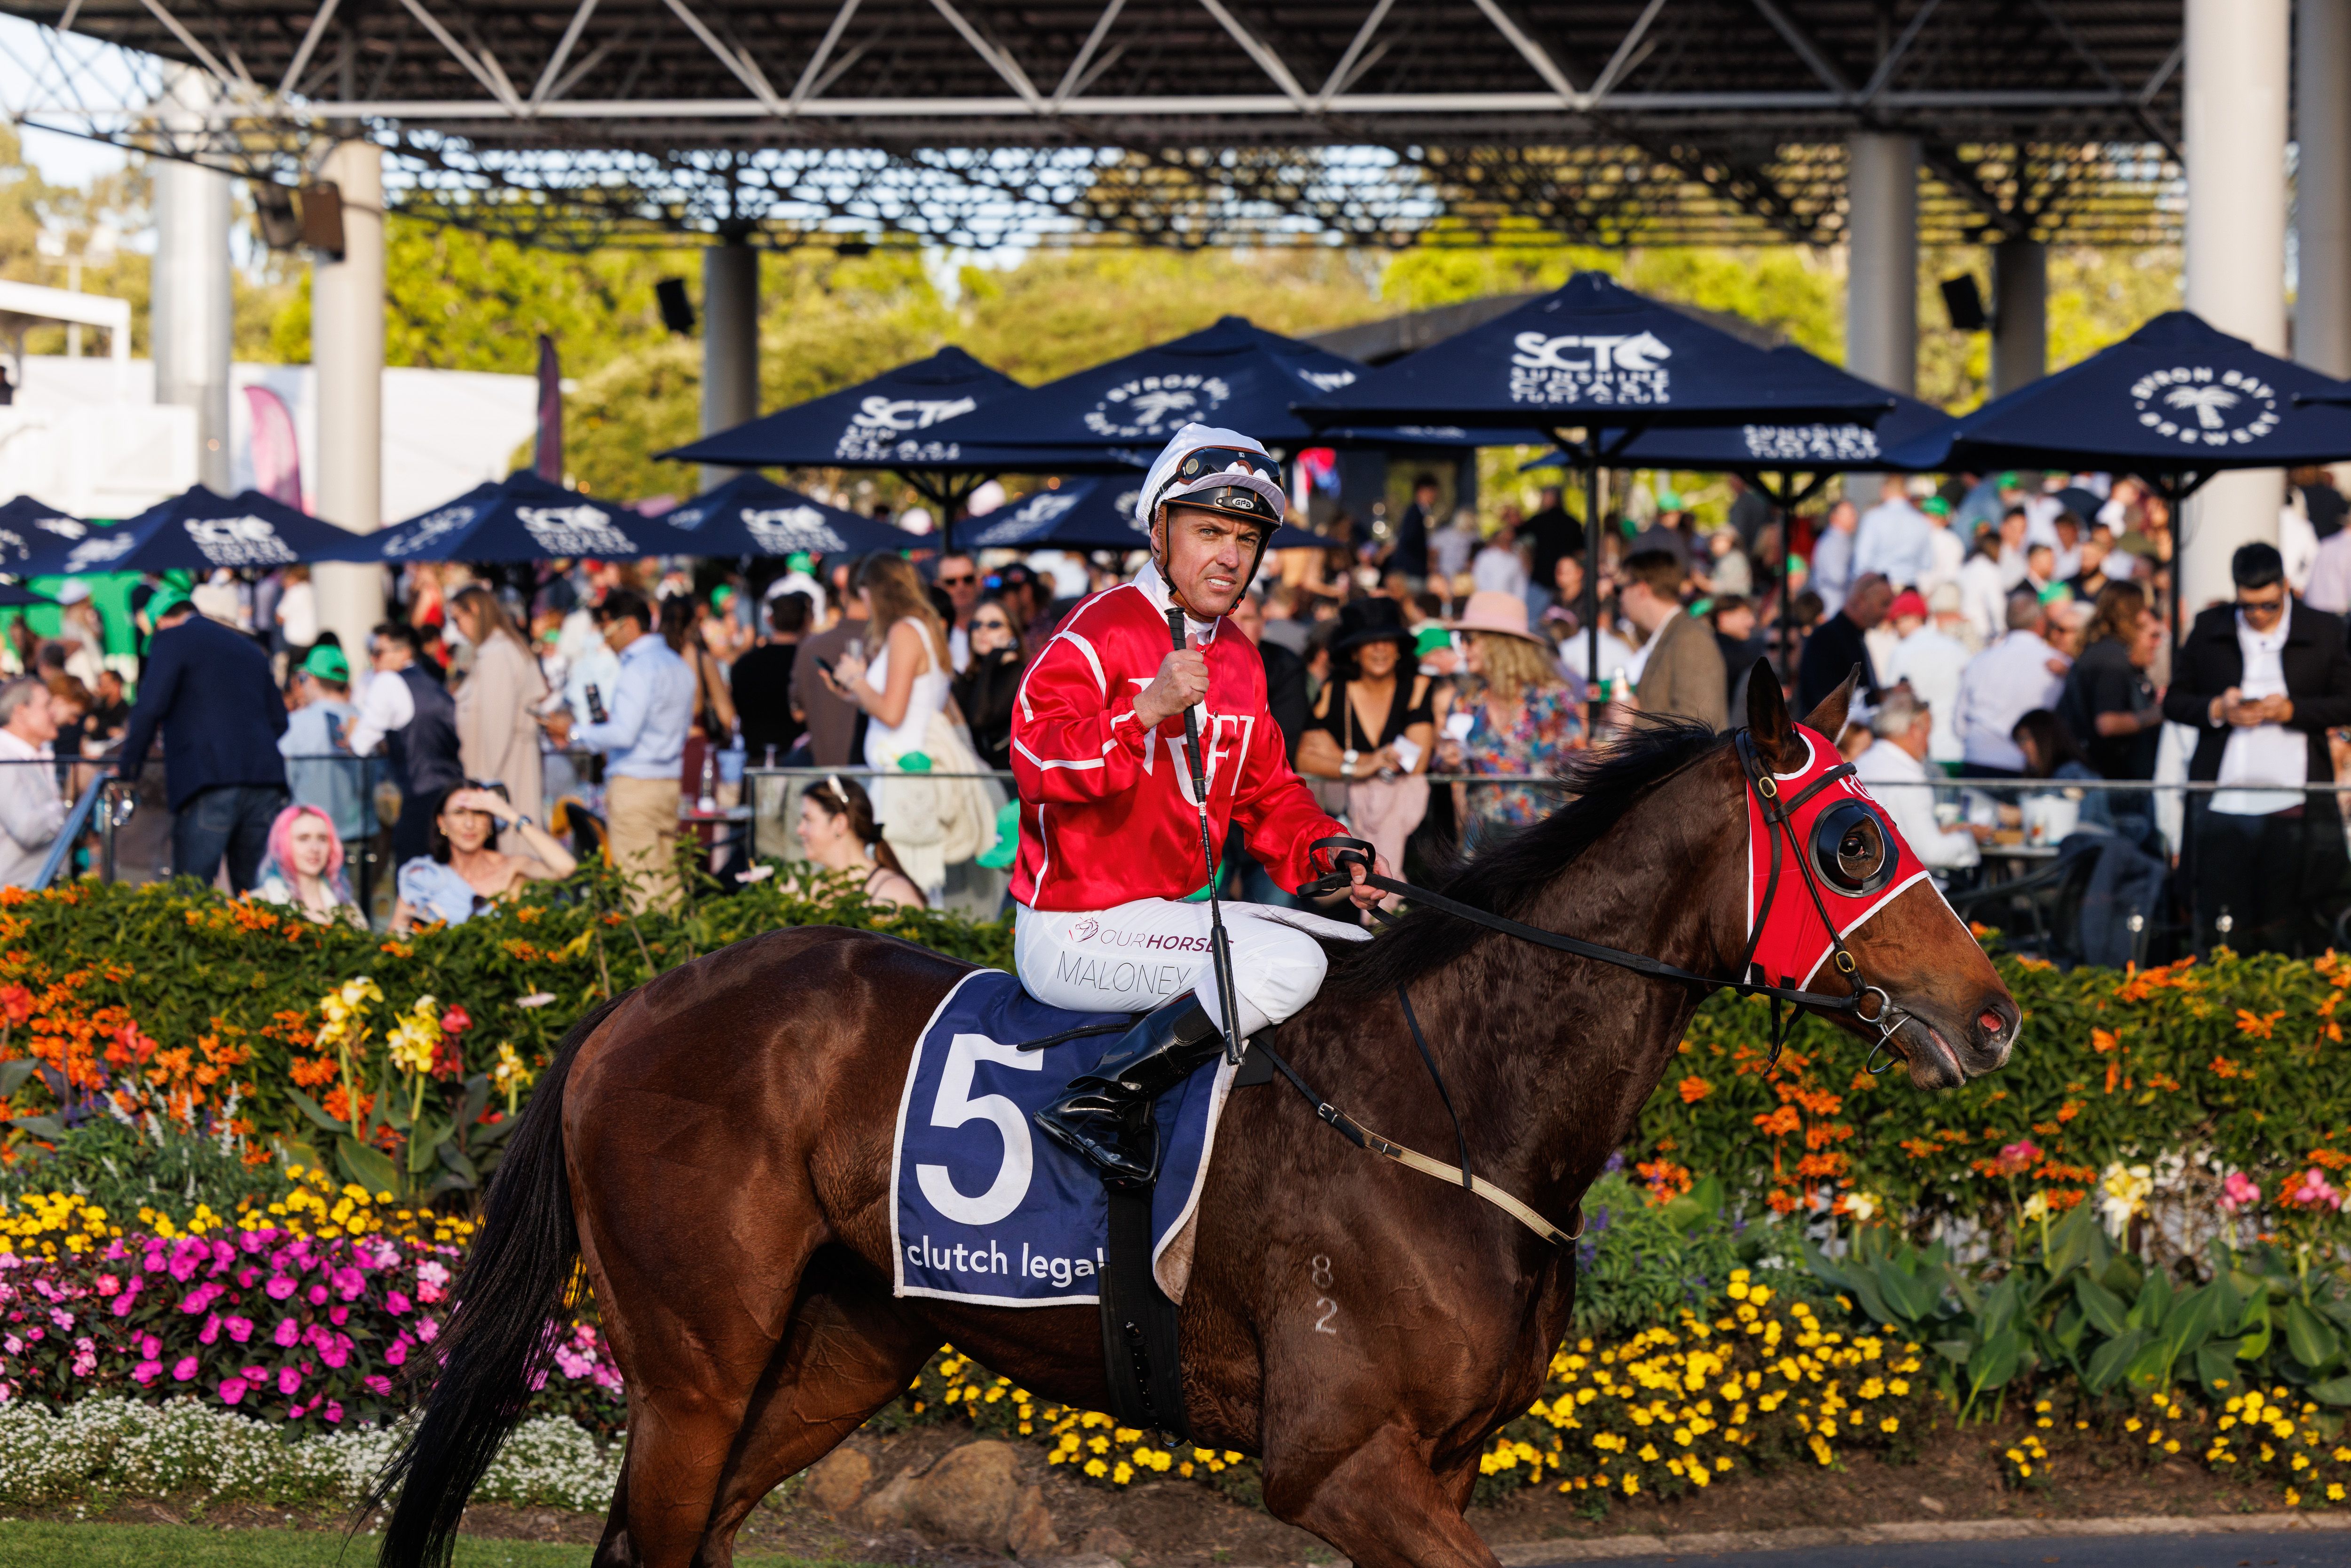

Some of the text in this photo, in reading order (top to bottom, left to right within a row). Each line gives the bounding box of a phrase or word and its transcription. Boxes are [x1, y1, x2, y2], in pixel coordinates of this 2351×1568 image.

[1511, 331, 1625, 372] SCT
[2130, 366, 2276, 400] BYRON BAY
[2138, 410, 2281, 446] BREWERY
[1057, 951, 1191, 995] MALONEY
[915, 1033, 1044, 1225] 5
[907, 1235, 1104, 1287] clutch legal
[1312, 1252, 1333, 1288] 8
[1316, 1296, 1337, 1334] 2
